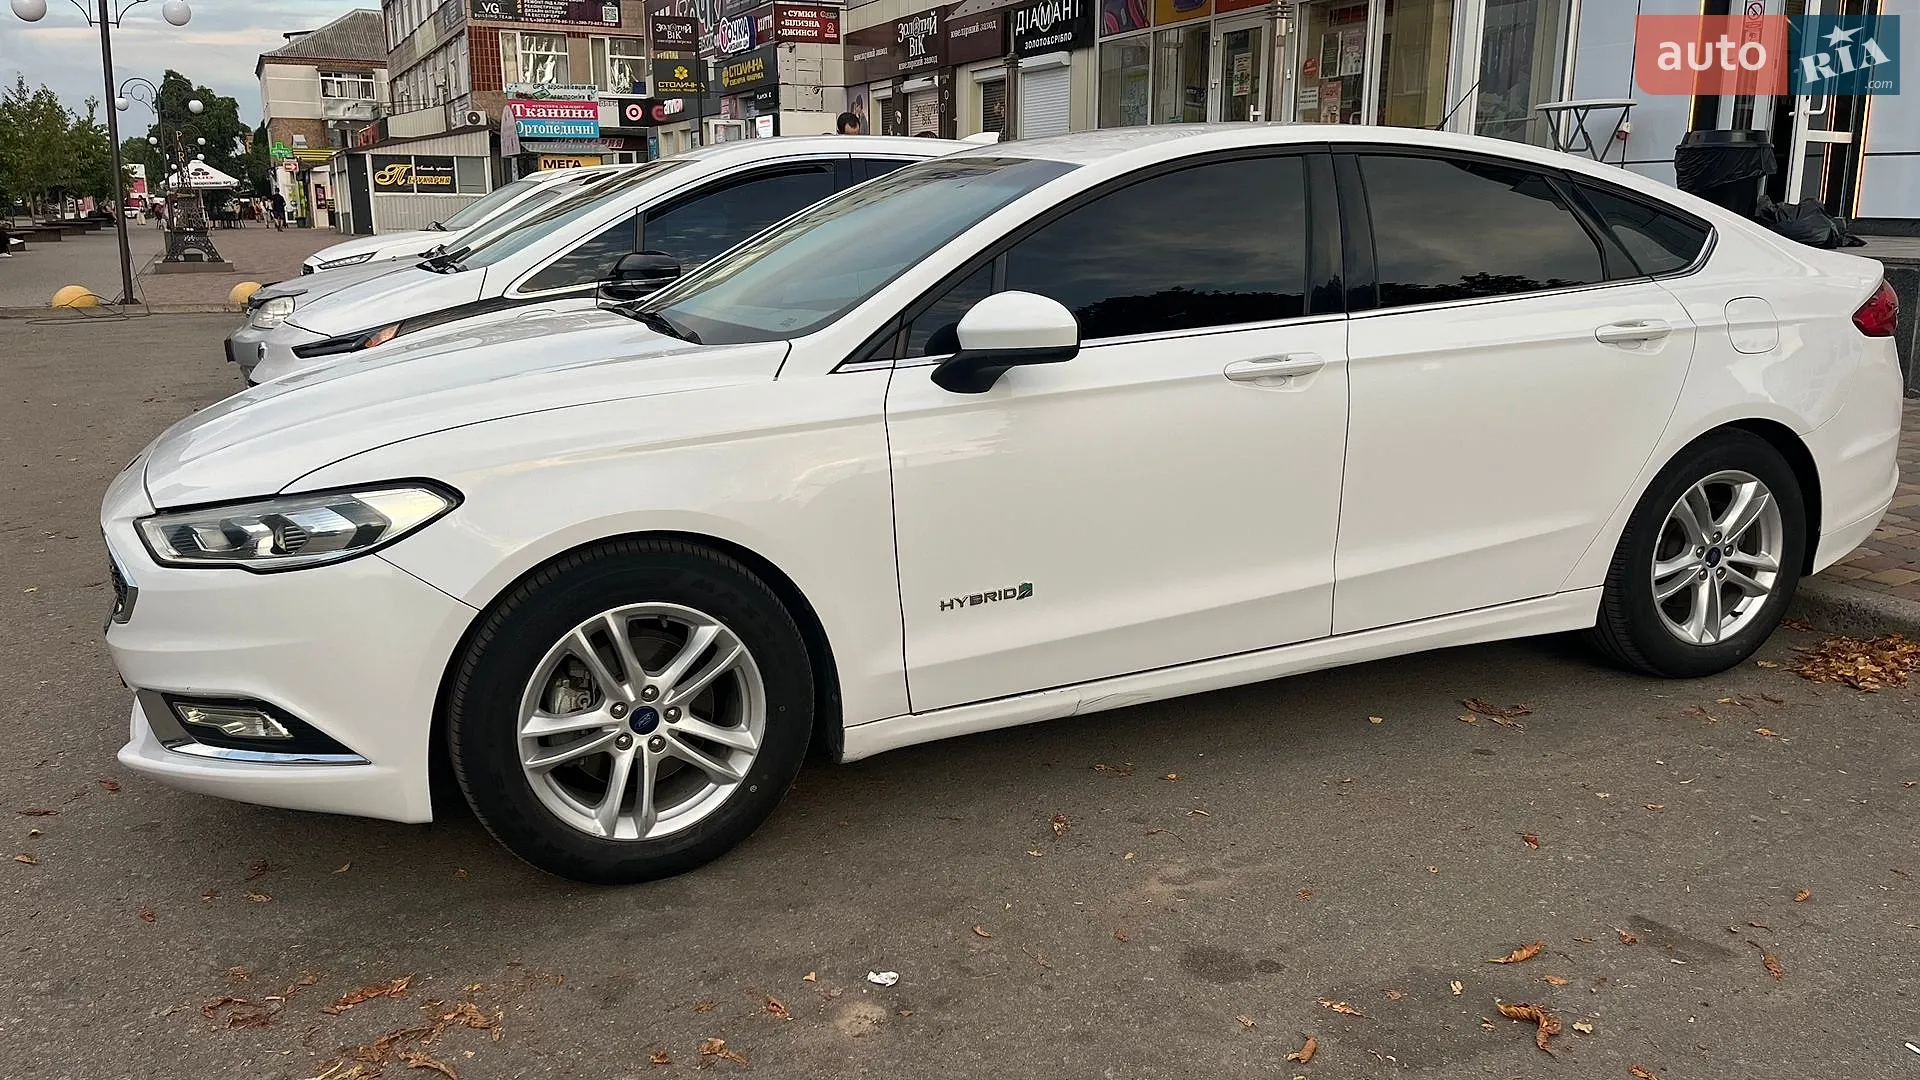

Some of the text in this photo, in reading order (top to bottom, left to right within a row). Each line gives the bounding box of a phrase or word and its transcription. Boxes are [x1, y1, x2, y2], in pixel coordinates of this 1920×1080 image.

[482, 2, 499, 13] VG
[788, 10, 817, 18] СУМКИ
[784, 20, 820, 28] БІЛИЗНА
[781, 28, 818, 37] ДЖИНСИ
[1024, 32, 1072, 50] ЗОЛОТО&СРІБЛО
[511, 103, 596, 118] Тканини
[543, 159, 582, 168] МЕГА
[940, 587, 1017, 612] HYBRID
